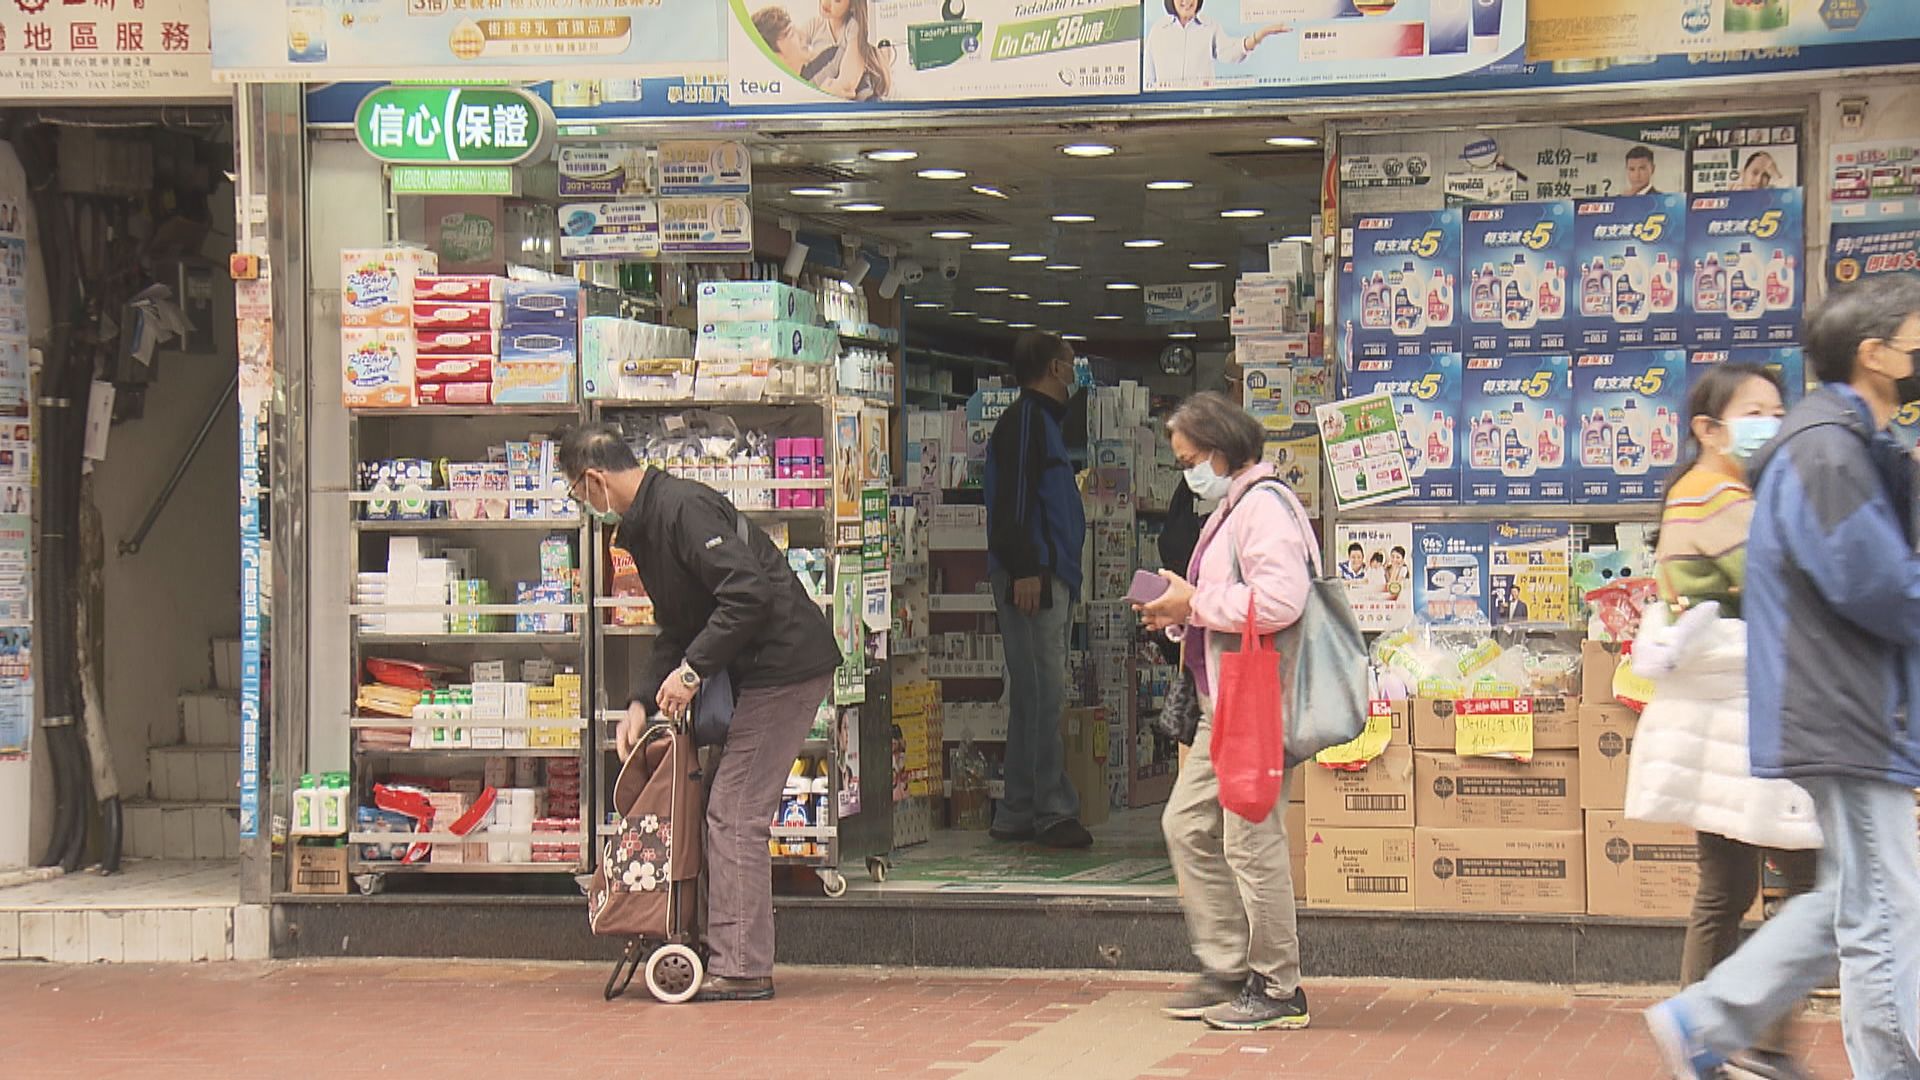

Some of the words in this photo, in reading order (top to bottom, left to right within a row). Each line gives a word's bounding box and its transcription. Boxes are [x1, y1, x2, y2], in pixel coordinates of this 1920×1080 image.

[0, 22, 212, 51] 地區服務
[998, 36, 1017, 58] On
[1021, 30, 1050, 54] Call
[741, 79, 781, 94] teva
[369, 104, 441, 147] 信心
[457, 104, 528, 148] 保證
[1537, 148, 1598, 166] 成份一樣
[664, 204, 707, 219] 2021
